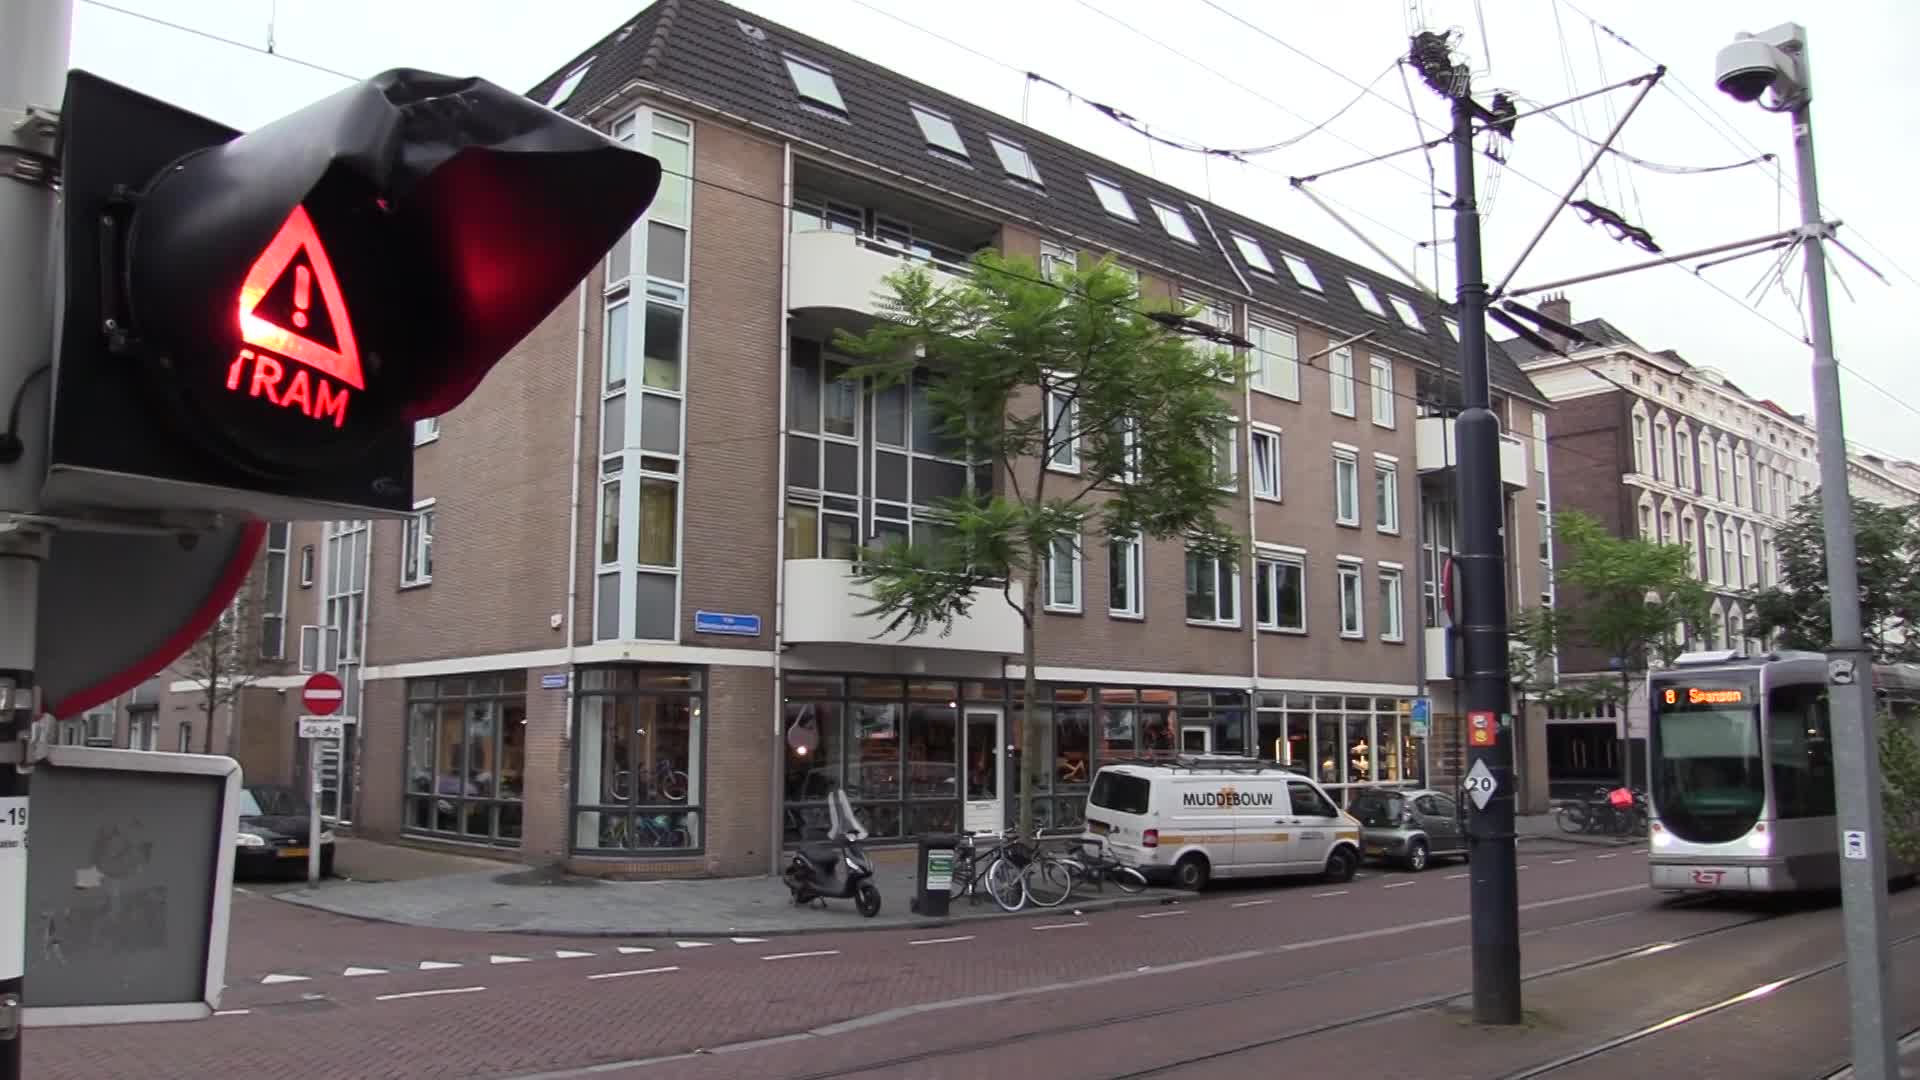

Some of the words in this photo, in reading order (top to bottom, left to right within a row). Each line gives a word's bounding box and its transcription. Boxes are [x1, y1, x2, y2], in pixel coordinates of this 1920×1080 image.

[227, 349, 350, 429] TRAM
[1665, 689, 1675, 704] 8
[1467, 777, 1491, 792] 20
[1183, 792, 1273, 806] MUDDEBOUW
